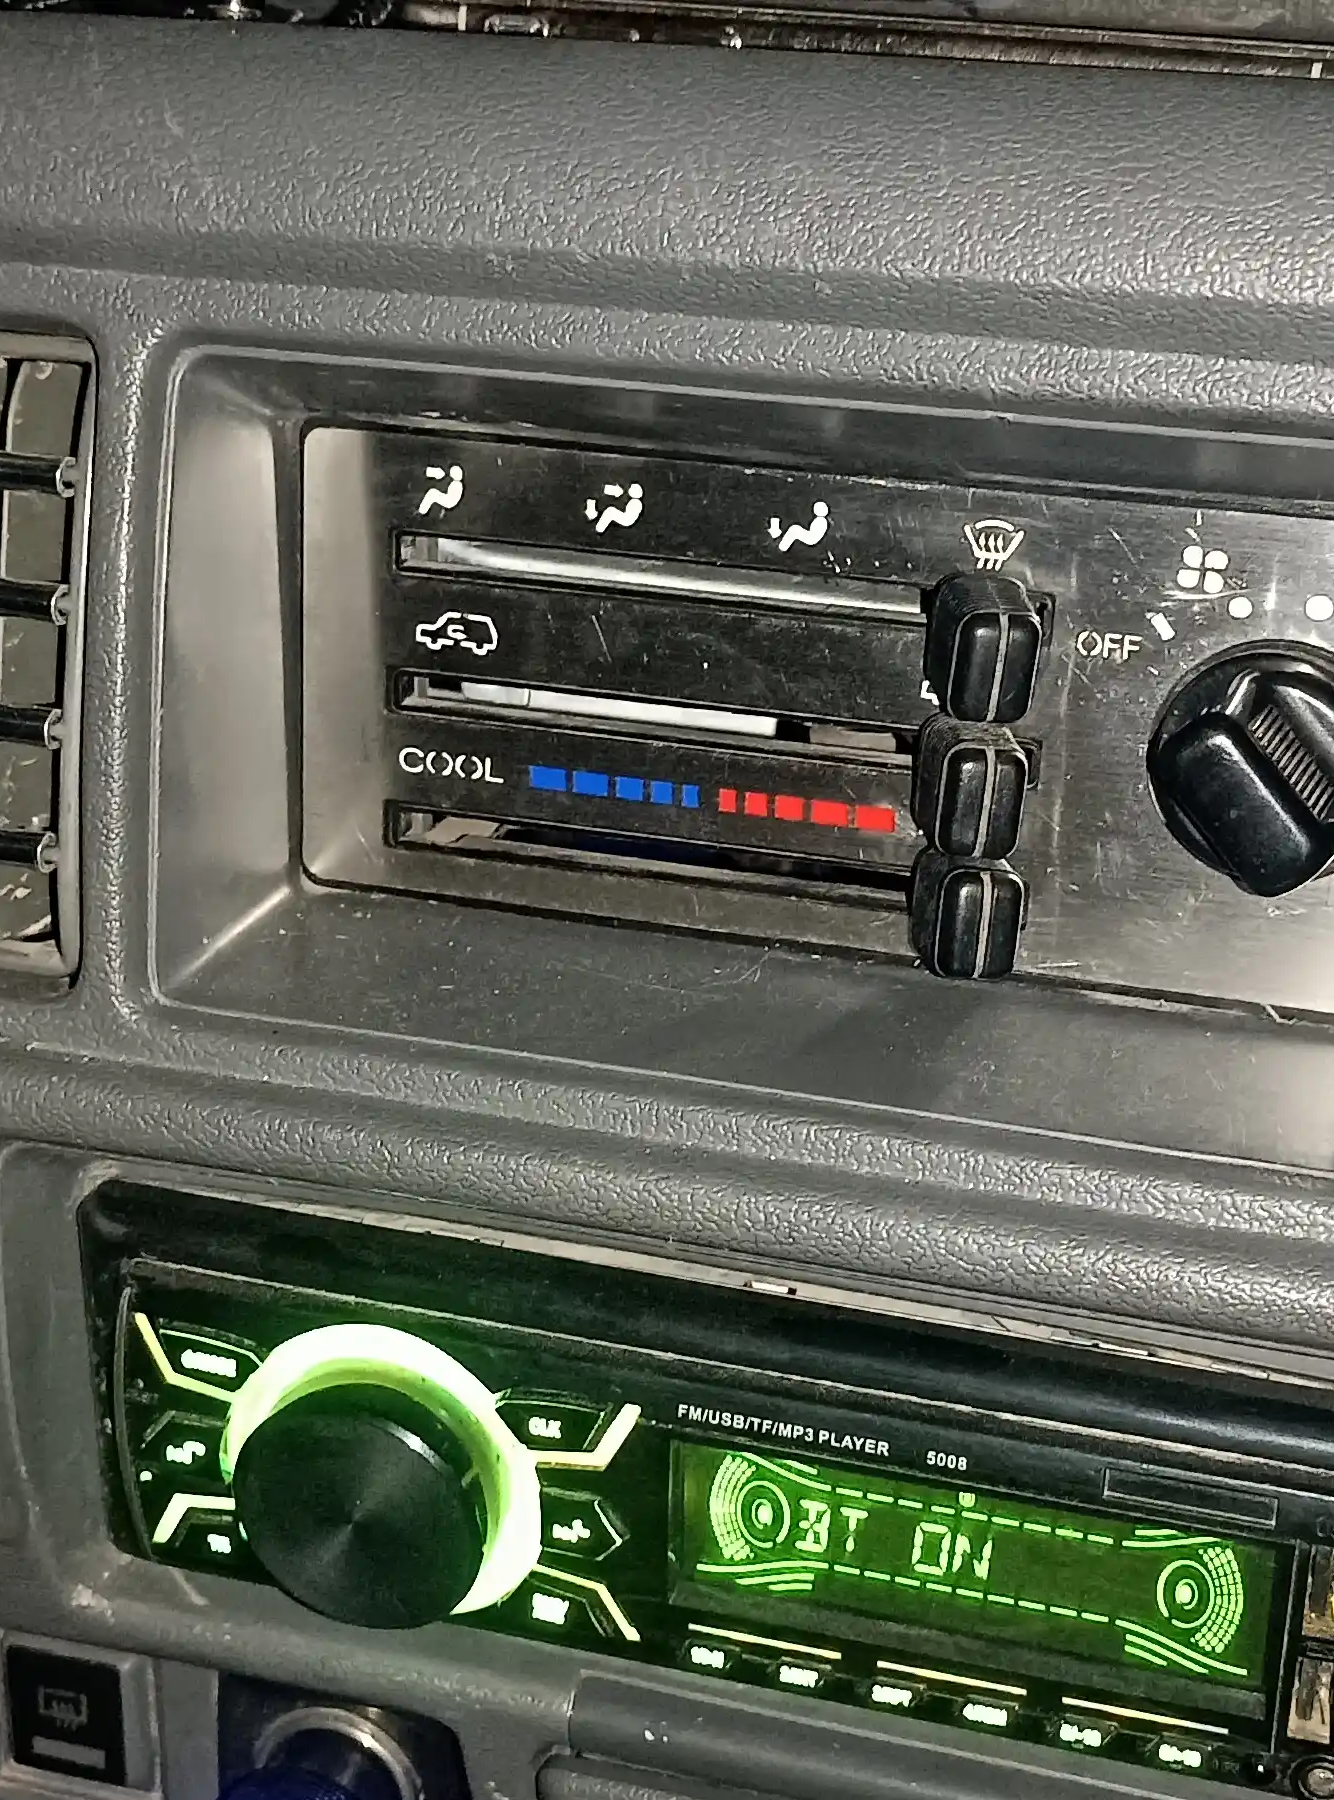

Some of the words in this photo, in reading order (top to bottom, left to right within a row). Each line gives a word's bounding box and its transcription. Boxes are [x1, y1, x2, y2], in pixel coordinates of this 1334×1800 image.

[1076, 630, 1143, 660] OFF
[398, 747, 504, 784] COOL
[677, 1404, 814, 1442] FM/USB/TF/MP3
[818, 1429, 890, 1457] PLAYER
[926, 1450, 968, 1471] 5008
[911, 1521, 994, 1581] ON
